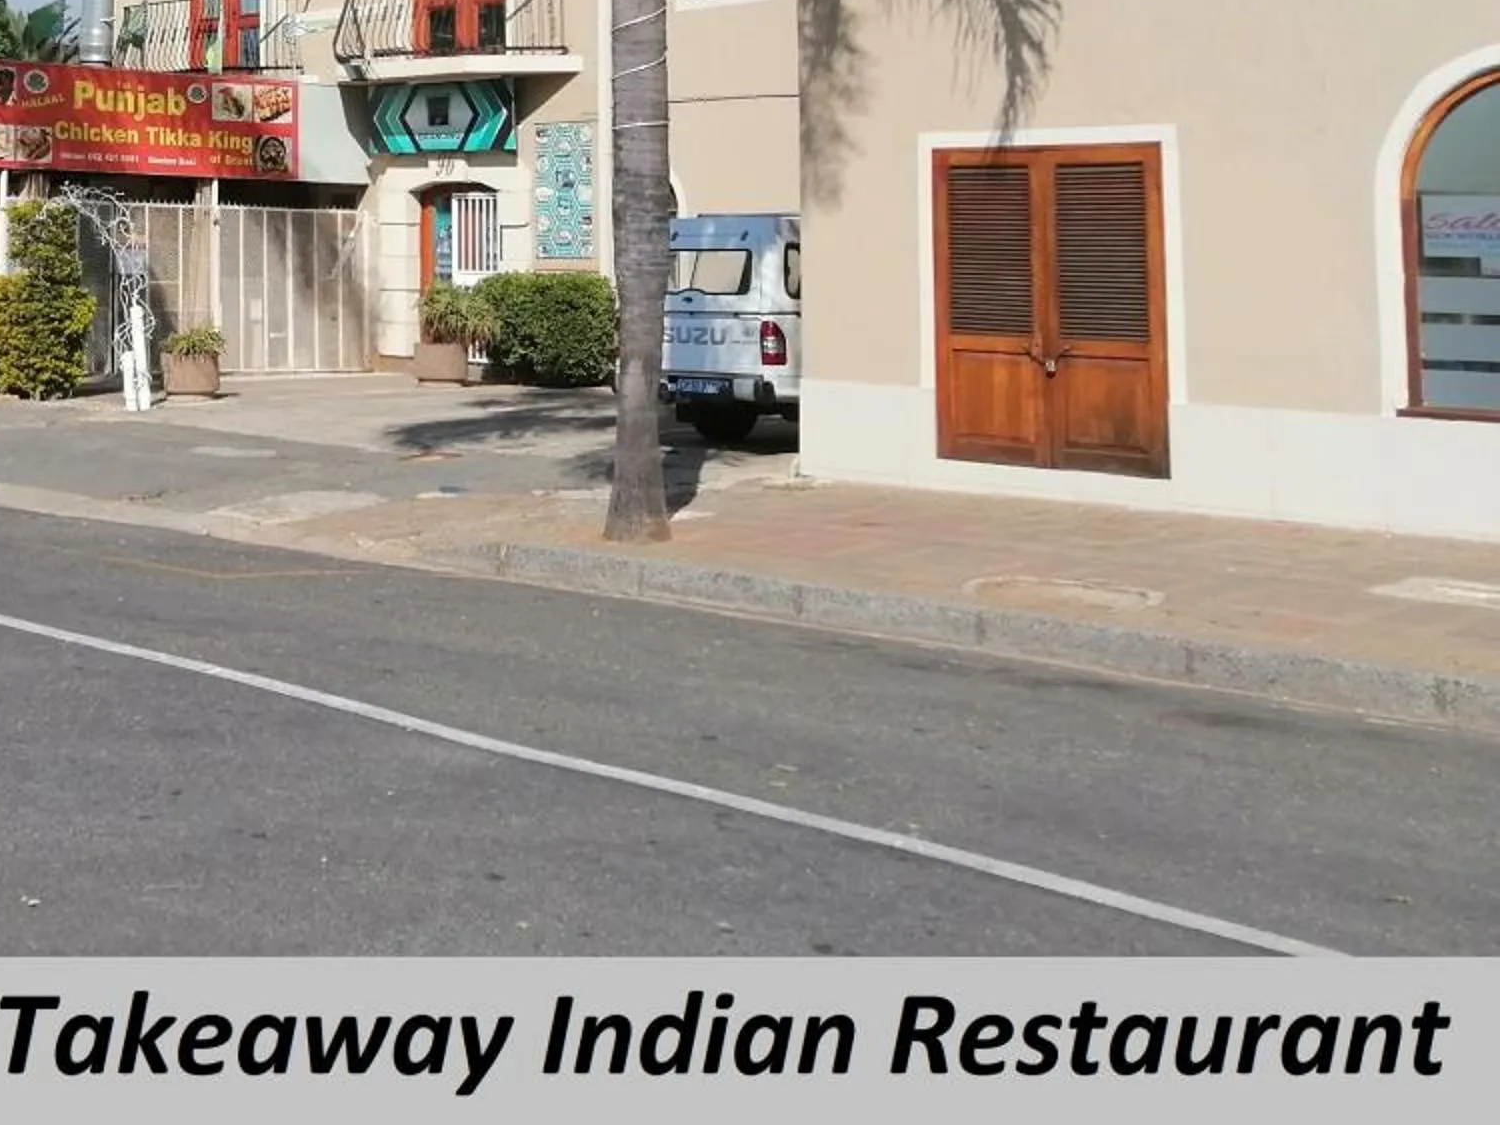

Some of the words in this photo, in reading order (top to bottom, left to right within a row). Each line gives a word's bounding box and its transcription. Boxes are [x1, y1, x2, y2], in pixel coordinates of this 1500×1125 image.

[74, 79, 187, 121] Punjab
[55, 120, 139, 145] Chicken
[146, 126, 202, 148] Tikka
[207, 129, 253, 154] King
[663, 326, 727, 346] SUZU
